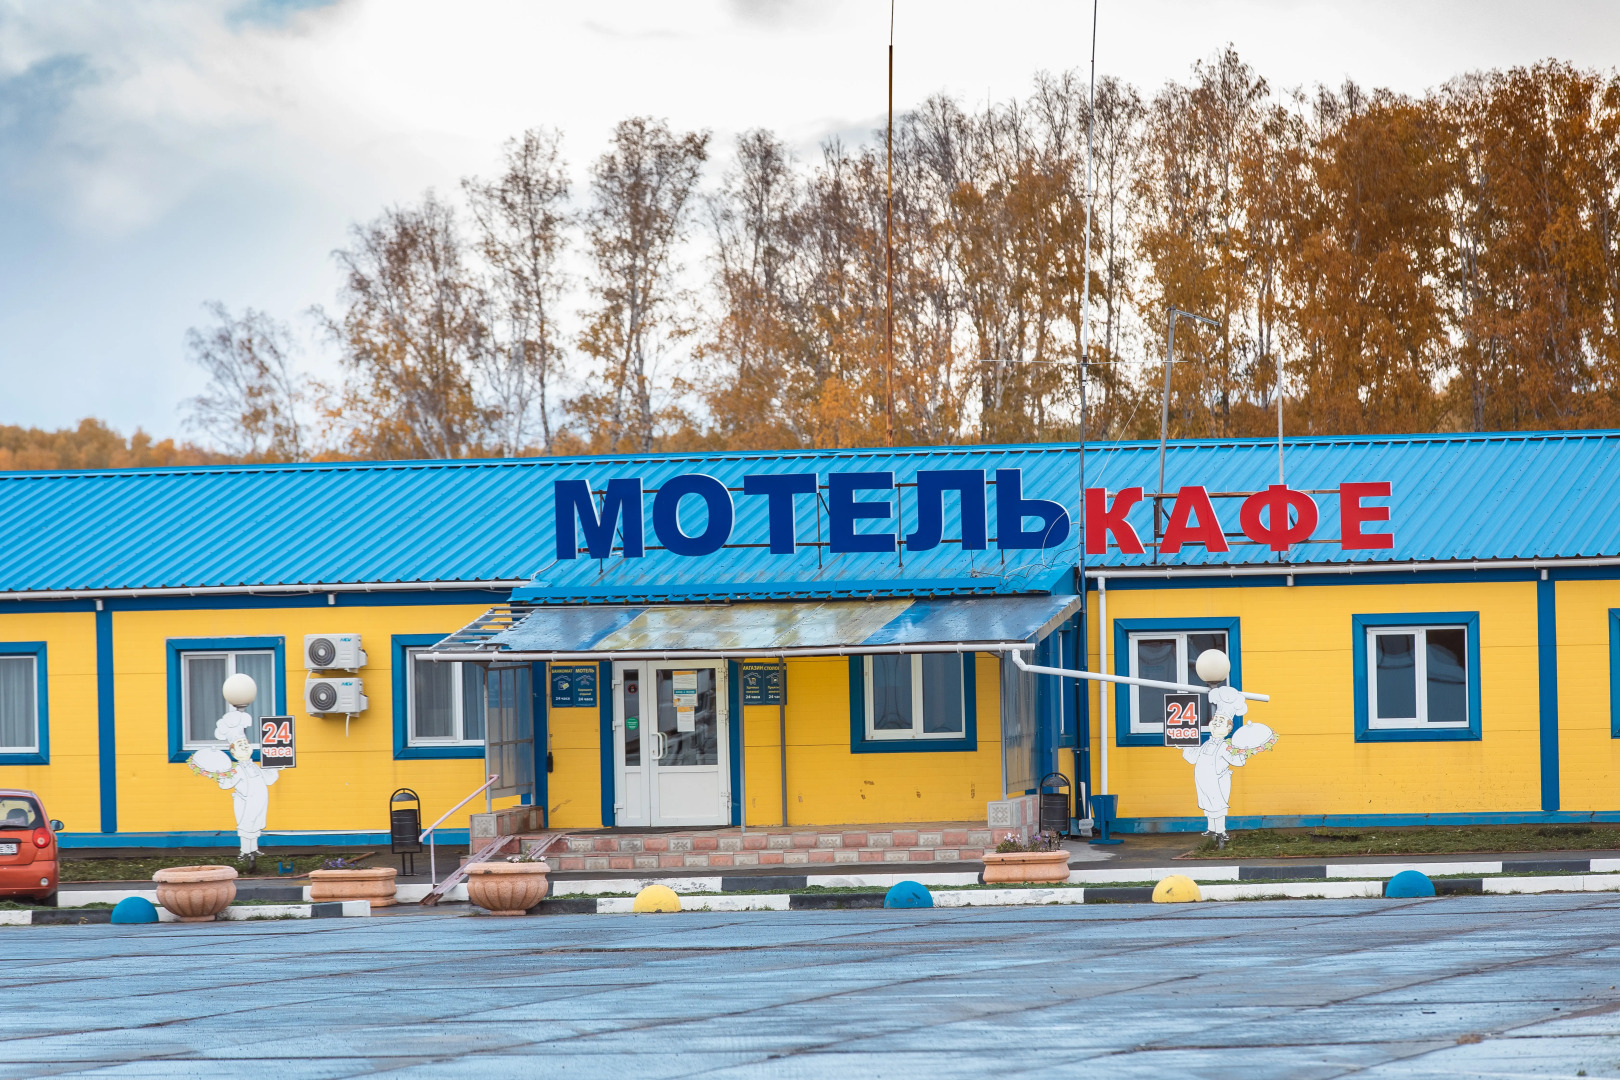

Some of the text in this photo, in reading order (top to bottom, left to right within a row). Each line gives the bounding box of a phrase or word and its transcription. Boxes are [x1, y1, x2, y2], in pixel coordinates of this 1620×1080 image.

[554, 468, 1071, 560] МОТЕЛЬ
[1084, 481, 1395, 555] КАФЕ
[1167, 702, 1197, 725] 24
[263, 722, 291, 744] 24
[1167, 728, 1198, 739] часа
[262, 747, 293, 758] часа
